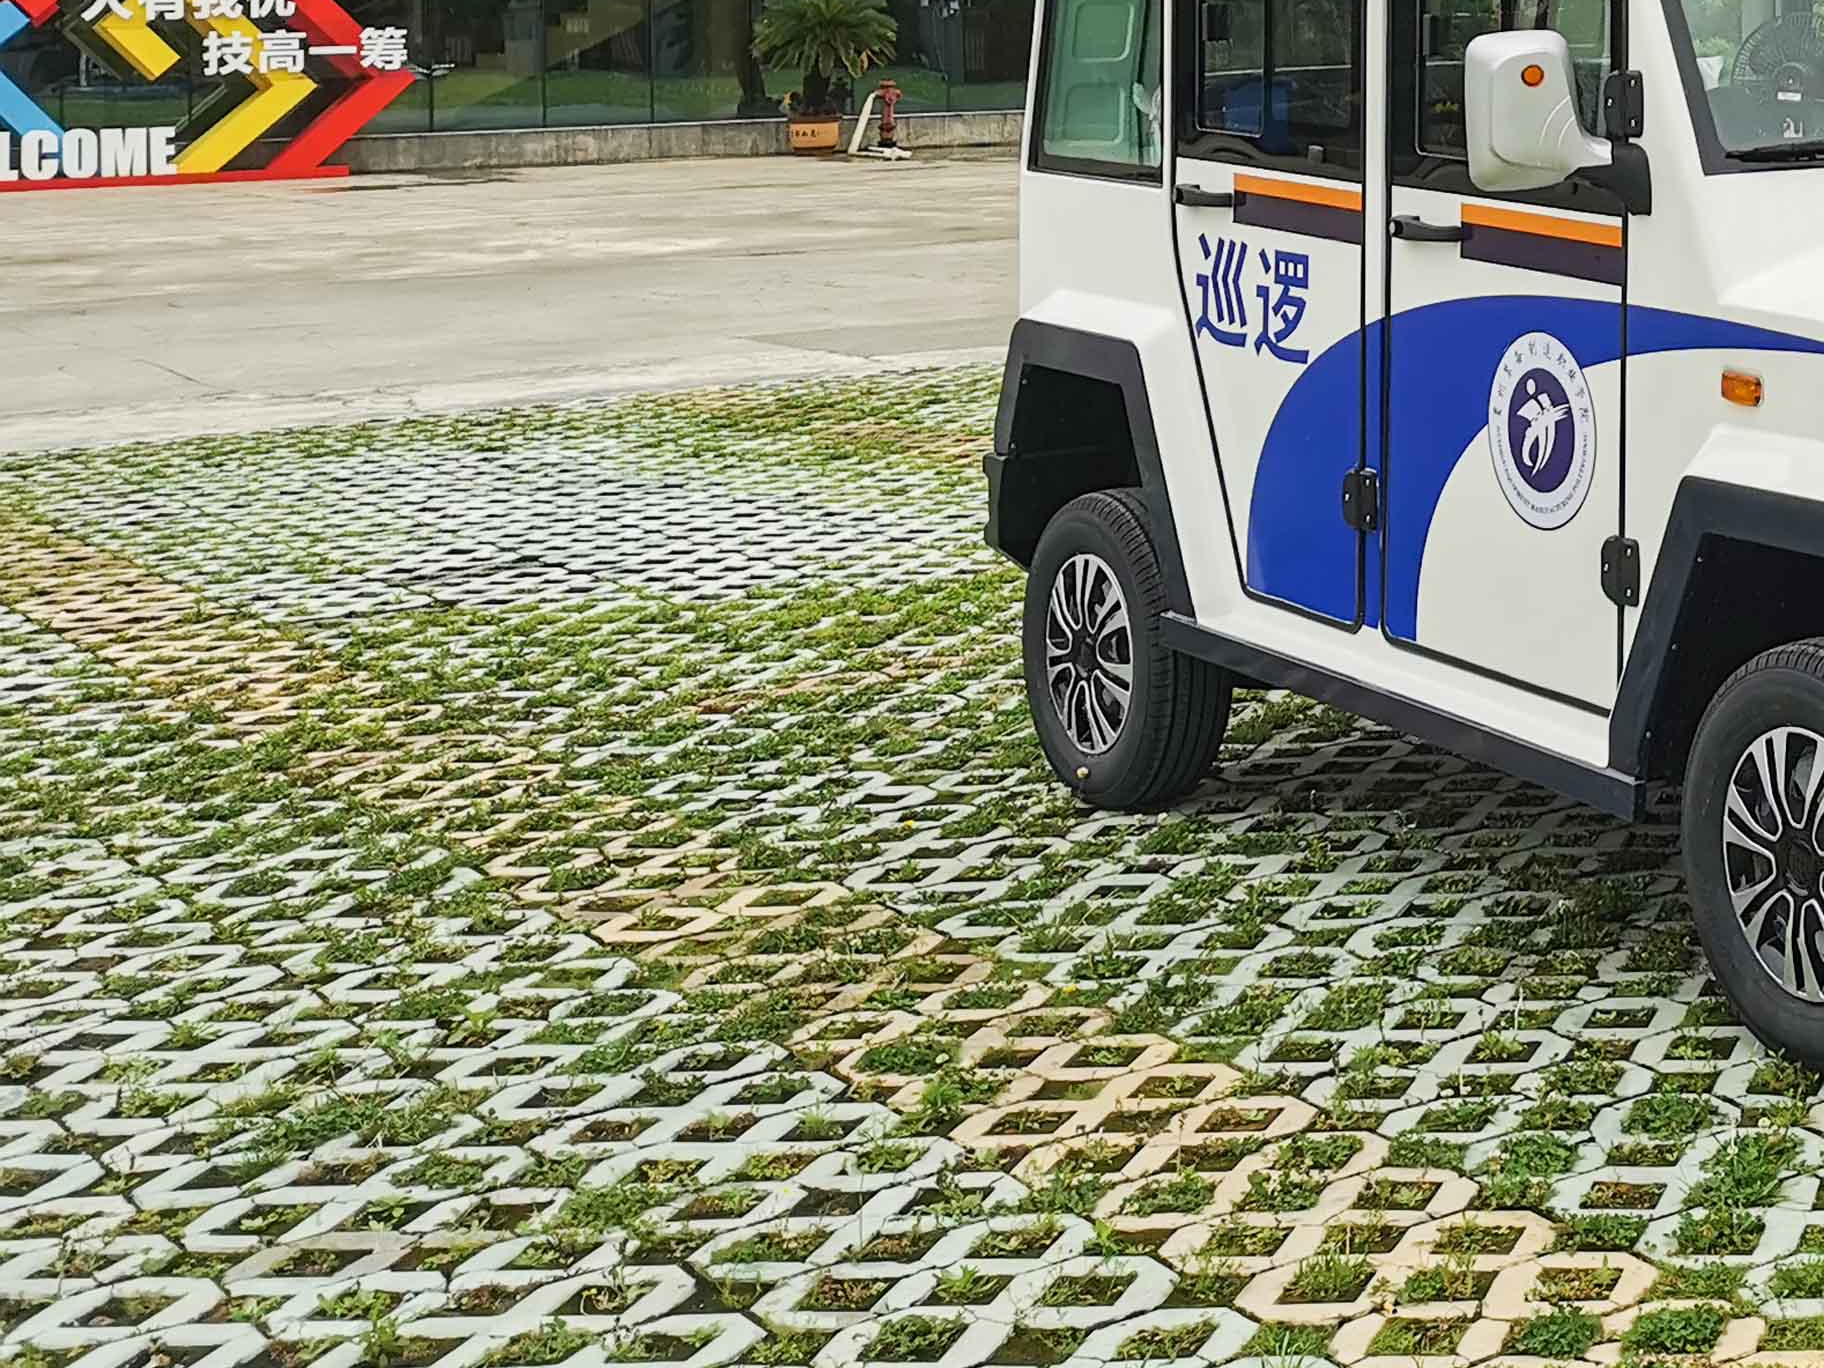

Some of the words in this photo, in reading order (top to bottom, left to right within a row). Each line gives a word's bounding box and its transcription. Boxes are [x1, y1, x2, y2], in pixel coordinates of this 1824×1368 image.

[202, 25, 408, 77] 技高一筹
[1195, 233, 1309, 364] 巡逻
